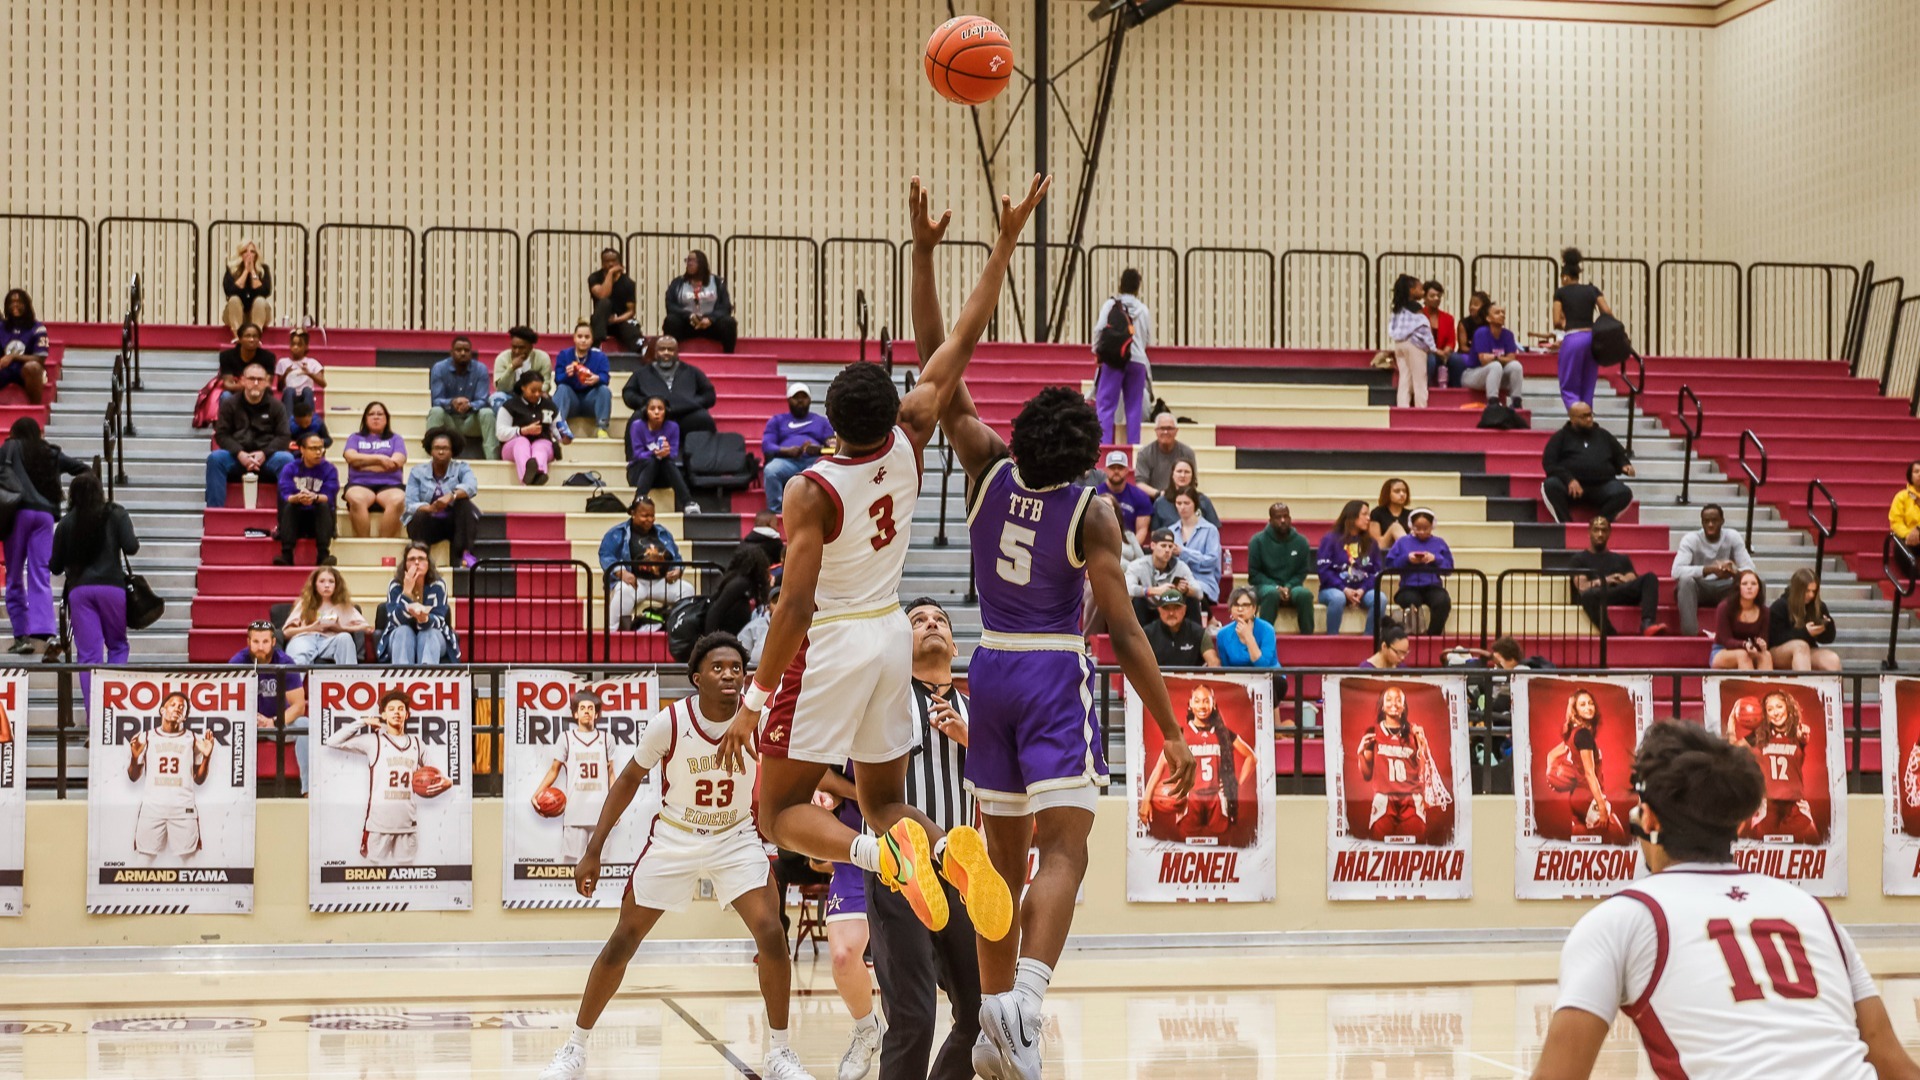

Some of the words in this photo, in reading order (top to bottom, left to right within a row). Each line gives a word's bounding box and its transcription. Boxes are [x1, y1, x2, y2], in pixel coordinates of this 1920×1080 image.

[1008, 492, 1044, 523] TFB
[868, 494, 897, 552] 3
[995, 520, 1036, 587] 5
[516, 681, 648, 711] ROGH
[115, 716, 232, 746] RIER
[159, 756, 180, 774] 23
[233, 723, 244, 785] BASKETBALL
[1769, 755, 1789, 781] 12
[389, 770, 410, 788] 24
[580, 763, 598, 779] 30
[1200, 757, 1213, 782] 5
[1387, 757, 1407, 782] 10
[695, 779, 735, 808] 23
[681, 807, 738, 826] RIDERS
[114, 870, 178, 882] ARMAND
[178, 870, 229, 882] EYAMA
[345, 868, 387, 881] BRIAN
[388, 867, 437, 880] ARMES
[527, 866, 576, 878] ZAIDEN
[1158, 851, 1240, 884] MCNEIL
[1332, 849, 1465, 882] MAZIMPAKA
[1533, 849, 1638, 882] ERICKSON
[1706, 918, 1819, 1003] 10
